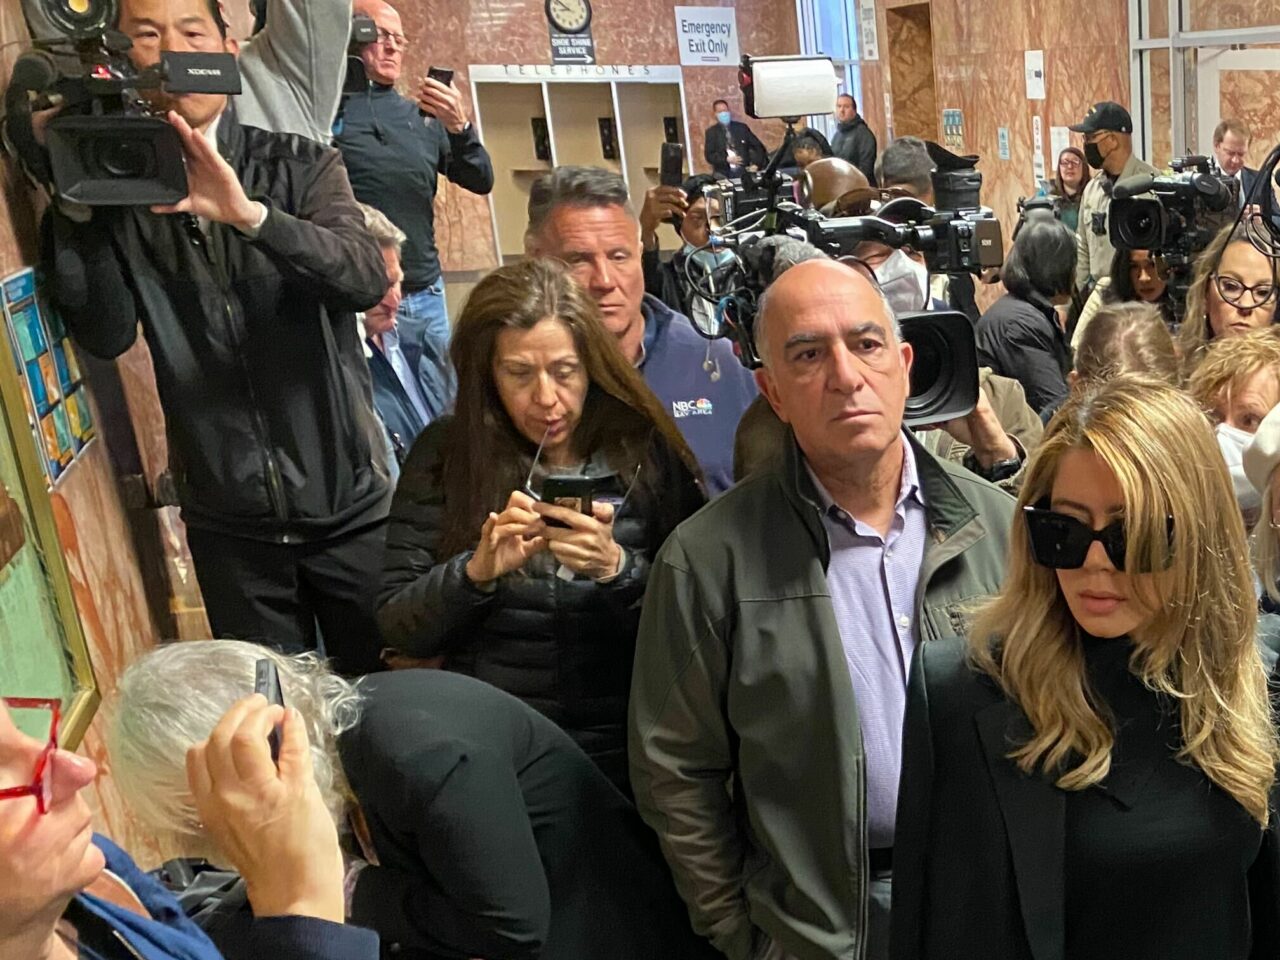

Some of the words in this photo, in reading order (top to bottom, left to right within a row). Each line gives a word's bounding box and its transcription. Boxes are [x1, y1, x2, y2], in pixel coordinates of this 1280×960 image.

[681, 19, 731, 38] Emergency
[551, 38, 570, 47] SHOE
[570, 38, 592, 47] SHINE
[558, 47, 587, 55] SERVICE
[688, 39, 706, 53] Exit
[707, 39, 728, 57] Only
[186, 68, 222, 76] XDCAM
[502, 65, 650, 75] TELEPHONES
[672, 400, 697, 411] NBC
